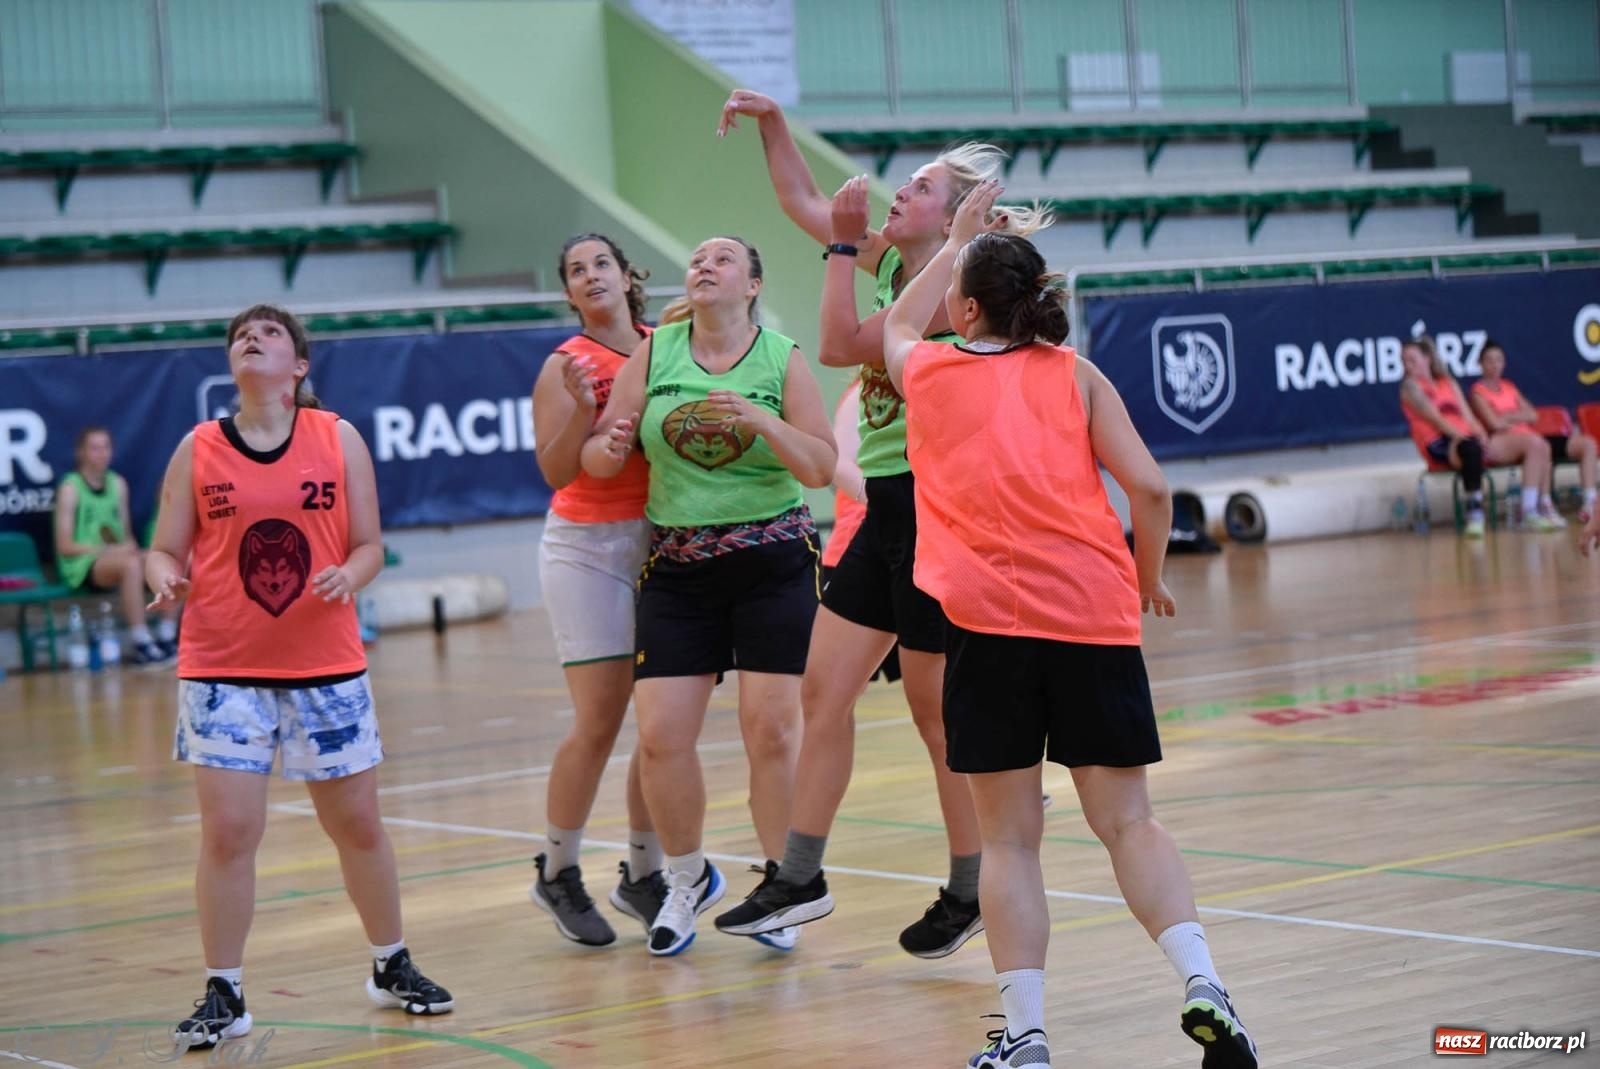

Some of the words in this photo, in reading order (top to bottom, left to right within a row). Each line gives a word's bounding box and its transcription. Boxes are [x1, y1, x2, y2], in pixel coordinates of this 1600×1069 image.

[1275, 319, 1486, 391] RACIBRZ
[201, 482, 235, 496] LETNIA
[301, 481, 336, 510] 25
[209, 495, 229, 508] LIGA
[207, 506, 237, 520] KOBIET
